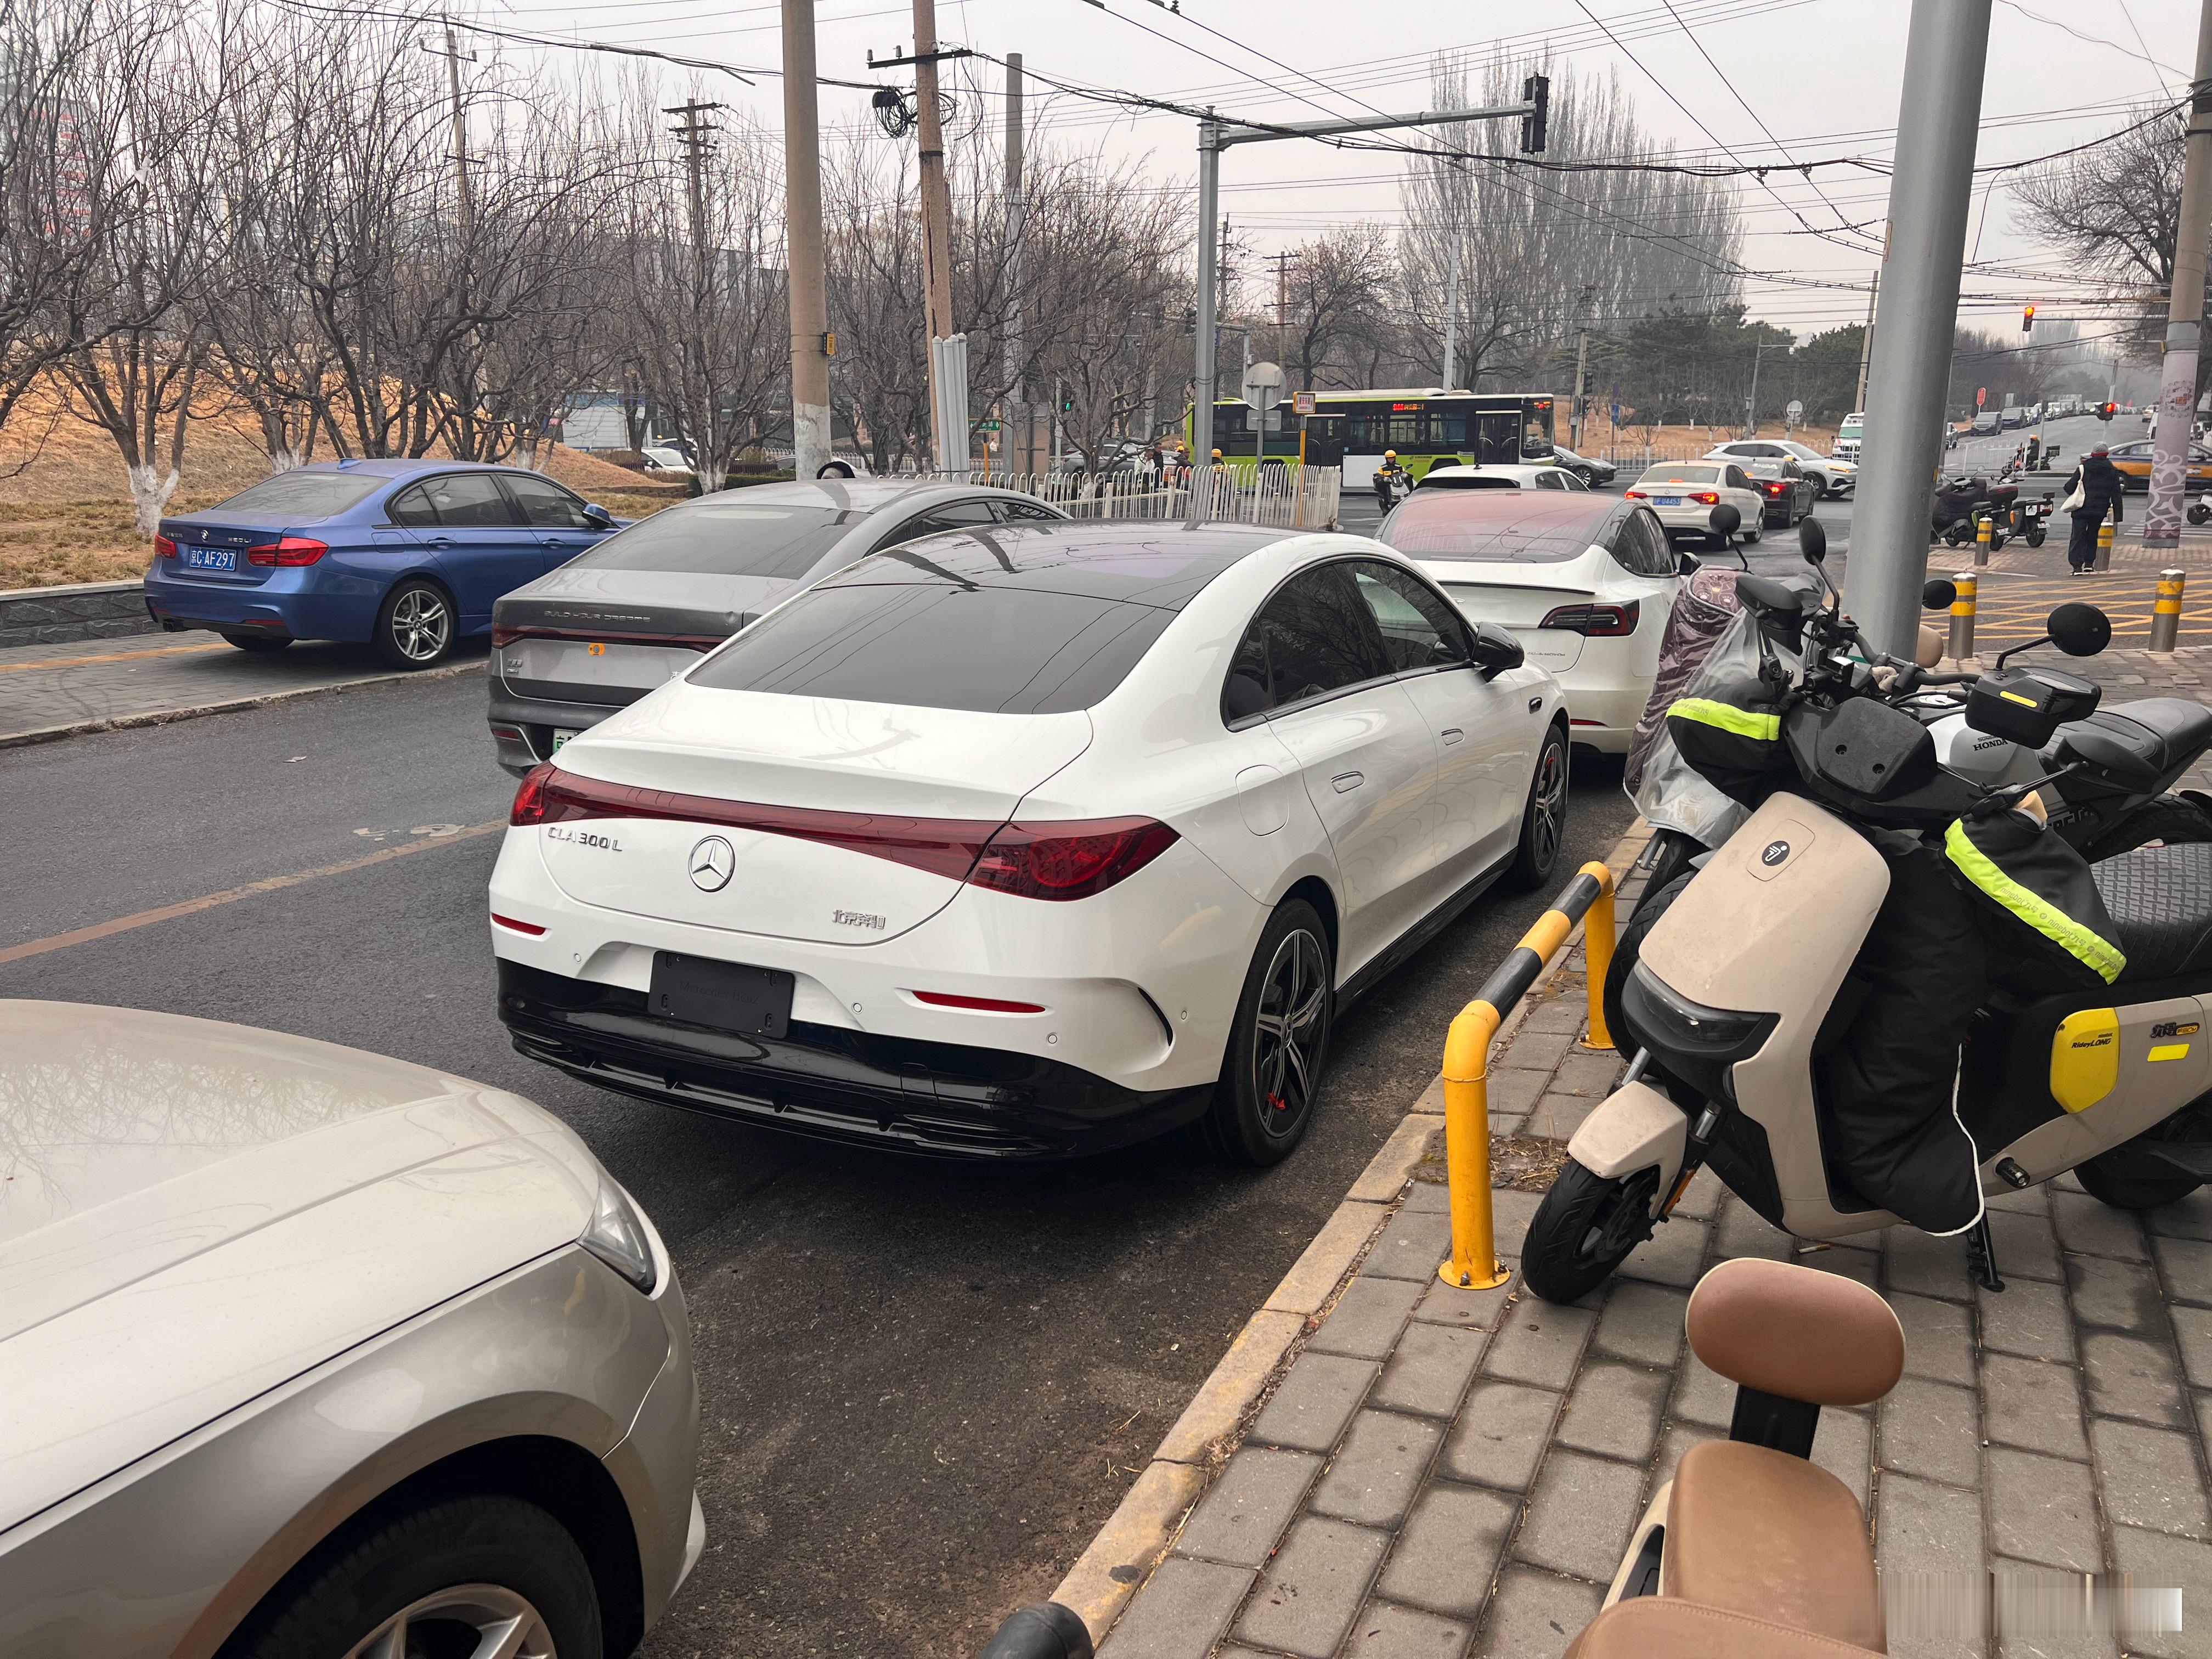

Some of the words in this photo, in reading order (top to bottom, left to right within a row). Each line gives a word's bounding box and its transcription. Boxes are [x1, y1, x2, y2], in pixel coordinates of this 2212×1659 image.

[1972, 738, 2008, 752] HONDA
[832, 910, 886, 930] 北京奔驰
[2071, 1038, 2112, 1048] RideyLONG
